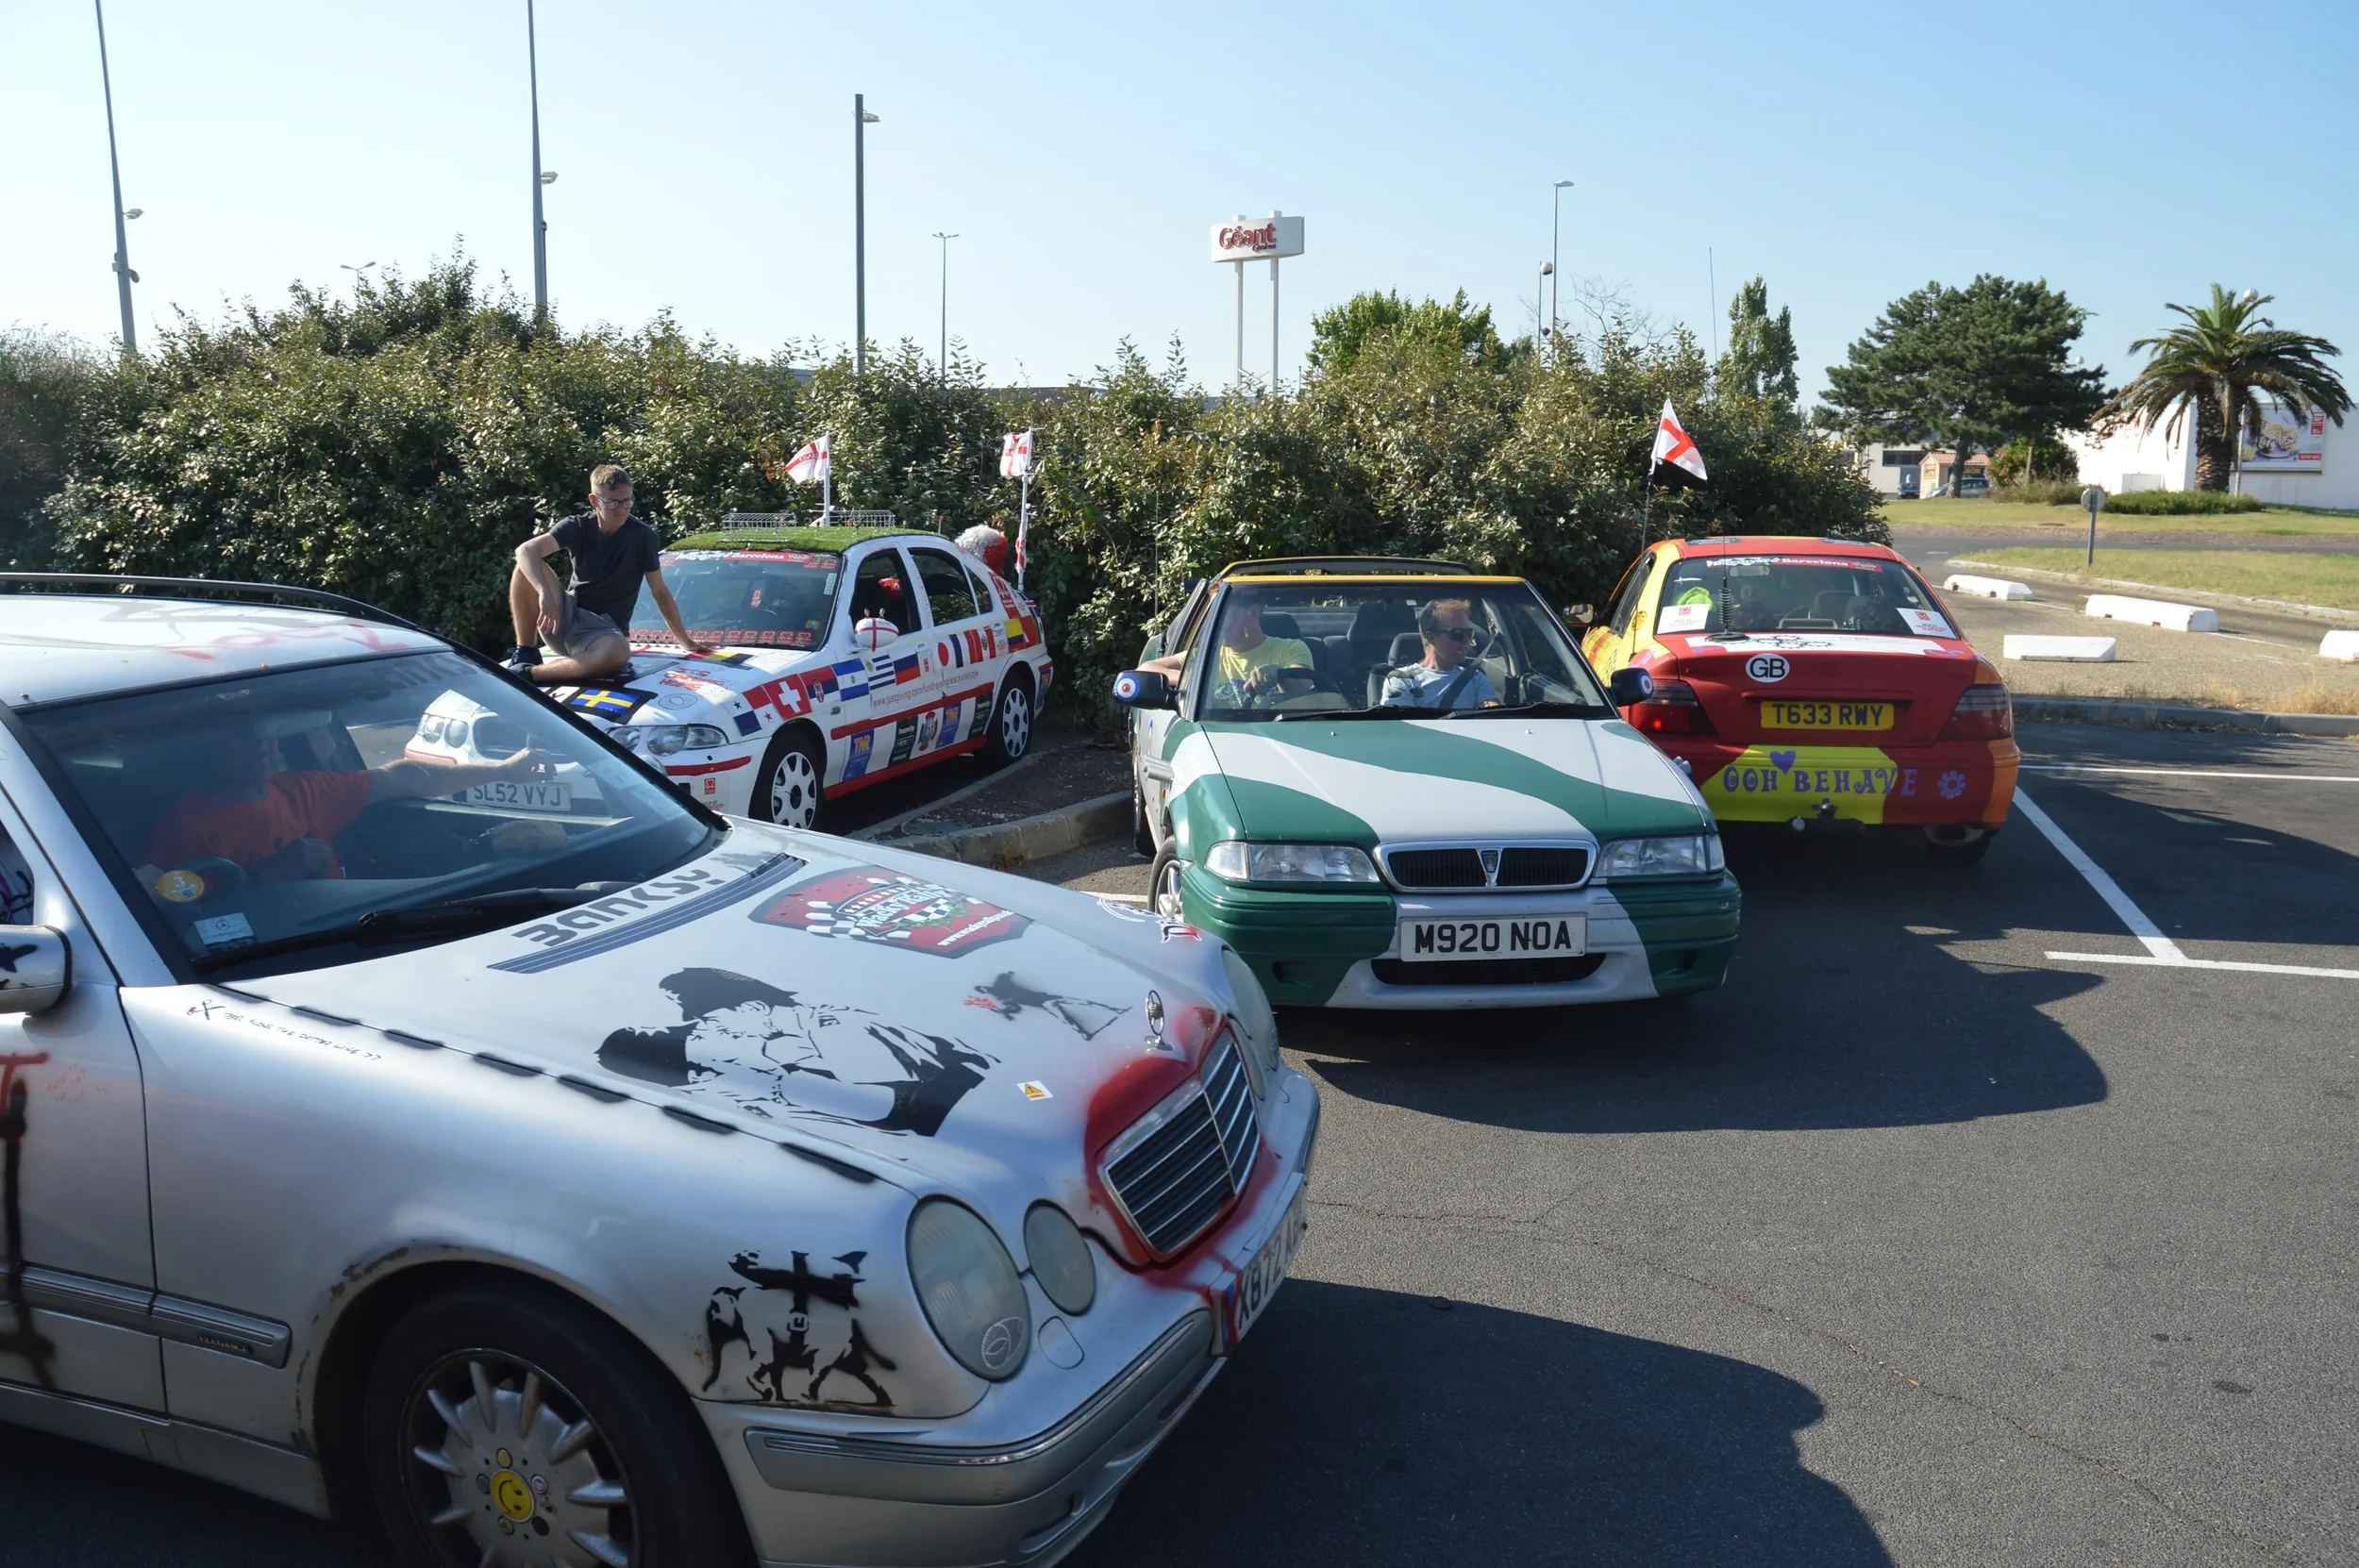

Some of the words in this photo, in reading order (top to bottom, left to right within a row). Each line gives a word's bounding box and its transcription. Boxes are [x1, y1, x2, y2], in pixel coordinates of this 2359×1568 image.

[1219, 223, 1277, 250] Géant
[1782, 558, 1849, 567] Barcelona
[1749, 658, 1785, 678] GB
[1771, 703, 1832, 725] T633
[1838, 704, 1883, 726] RWY
[1723, 765, 1779, 792] OOH
[1794, 768, 1917, 797] BEHAVE
[474, 782, 518, 804] SL52
[523, 783, 562, 807] VYJ
[856, 898, 911, 927] Wacky
[1414, 923, 1500, 954] M920
[1511, 920, 1572, 952] NOA
[276, 1026, 295, 1036] THE
[199, 1335, 250, 1354] ELEGANCE
